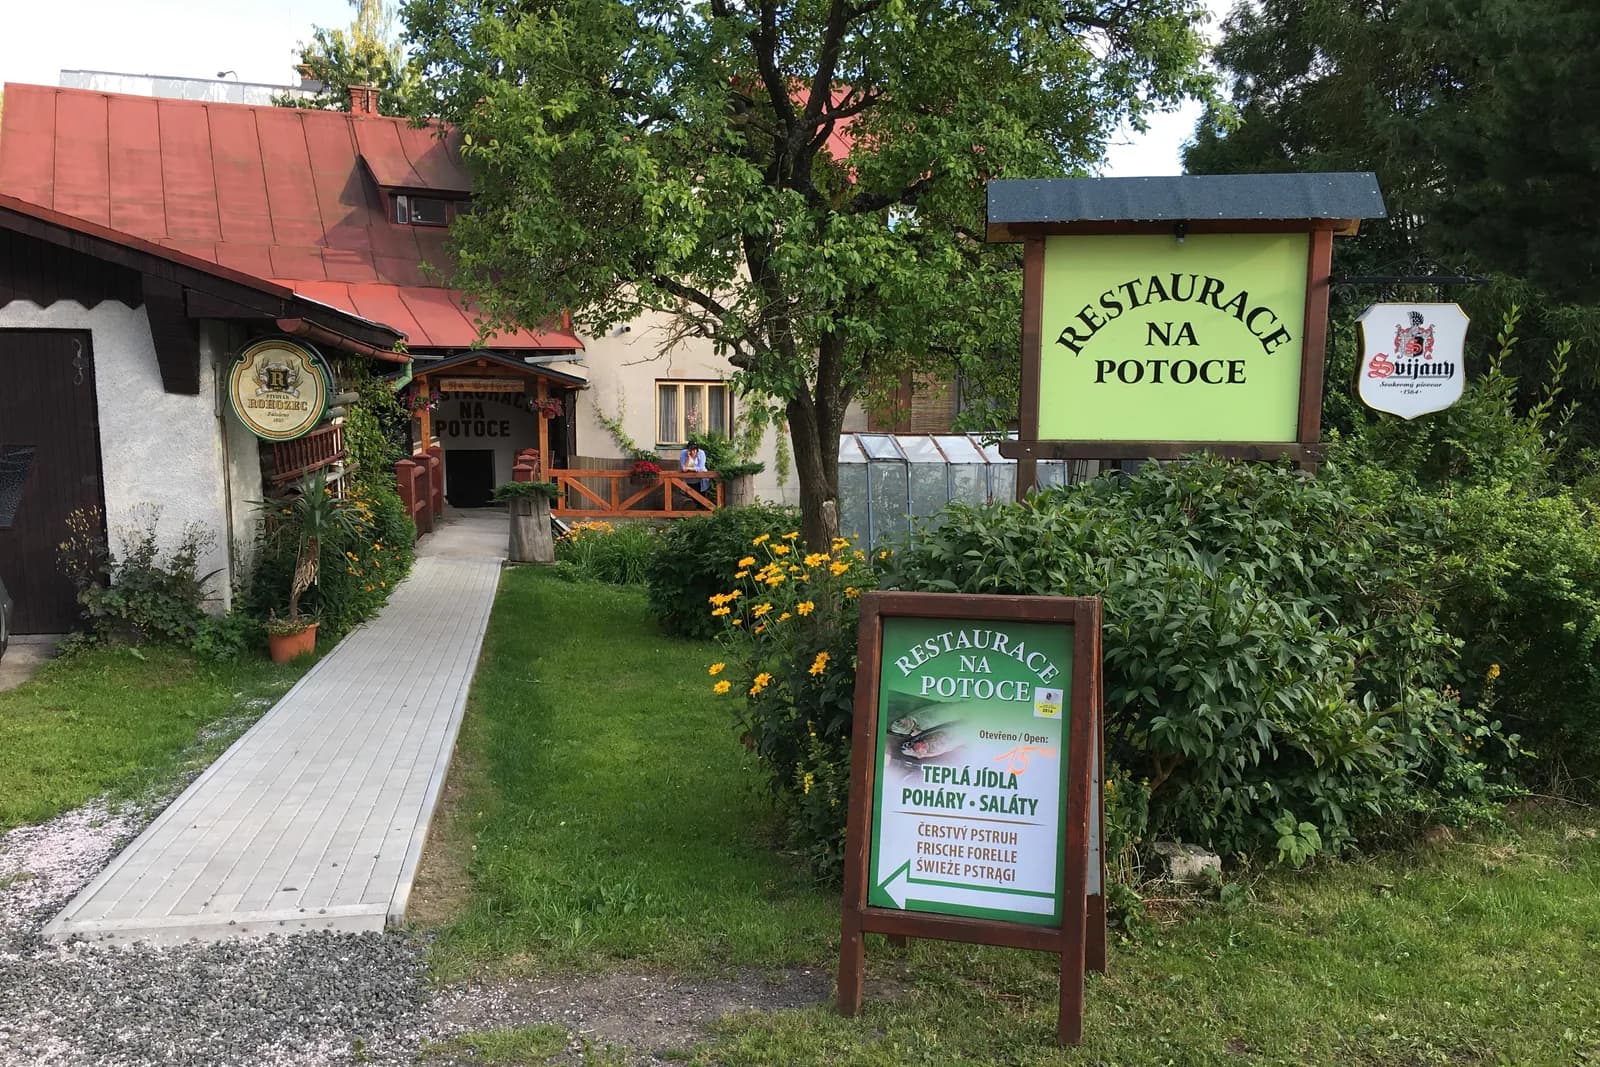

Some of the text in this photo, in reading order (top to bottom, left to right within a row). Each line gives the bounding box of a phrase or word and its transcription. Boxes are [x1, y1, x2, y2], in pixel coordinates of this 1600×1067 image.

[1055, 273, 1292, 357] RESTAURACE
[1145, 322, 1200, 346] NA
[271, 371, 285, 386] R
[1094, 359, 1247, 384] POTOCE
[1368, 353, 1455, 380] Svijany
[248, 399, 308, 411] ROHOZEC
[460, 402, 485, 419] NA
[435, 420, 511, 437] POTOCE
[894, 629, 1060, 684] RESTAURACE
[960, 655, 992, 673] NA
[920, 675, 1031, 702] POTOCE
[979, 730, 1017, 741] Otevřeno
[1024, 733, 1049, 745] Open:
[923, 765, 1018, 790] TEPLÁ JÍDLA
[902, 788, 1038, 816] POHÁRY SALÁTY
[918, 822, 1018, 845] ČERSTVÝ PSTRUH
[917, 841, 1017, 863] FRISCHE FORELLE
[916, 857, 1016, 883] ŚWIEŻE PSTRĄGI
